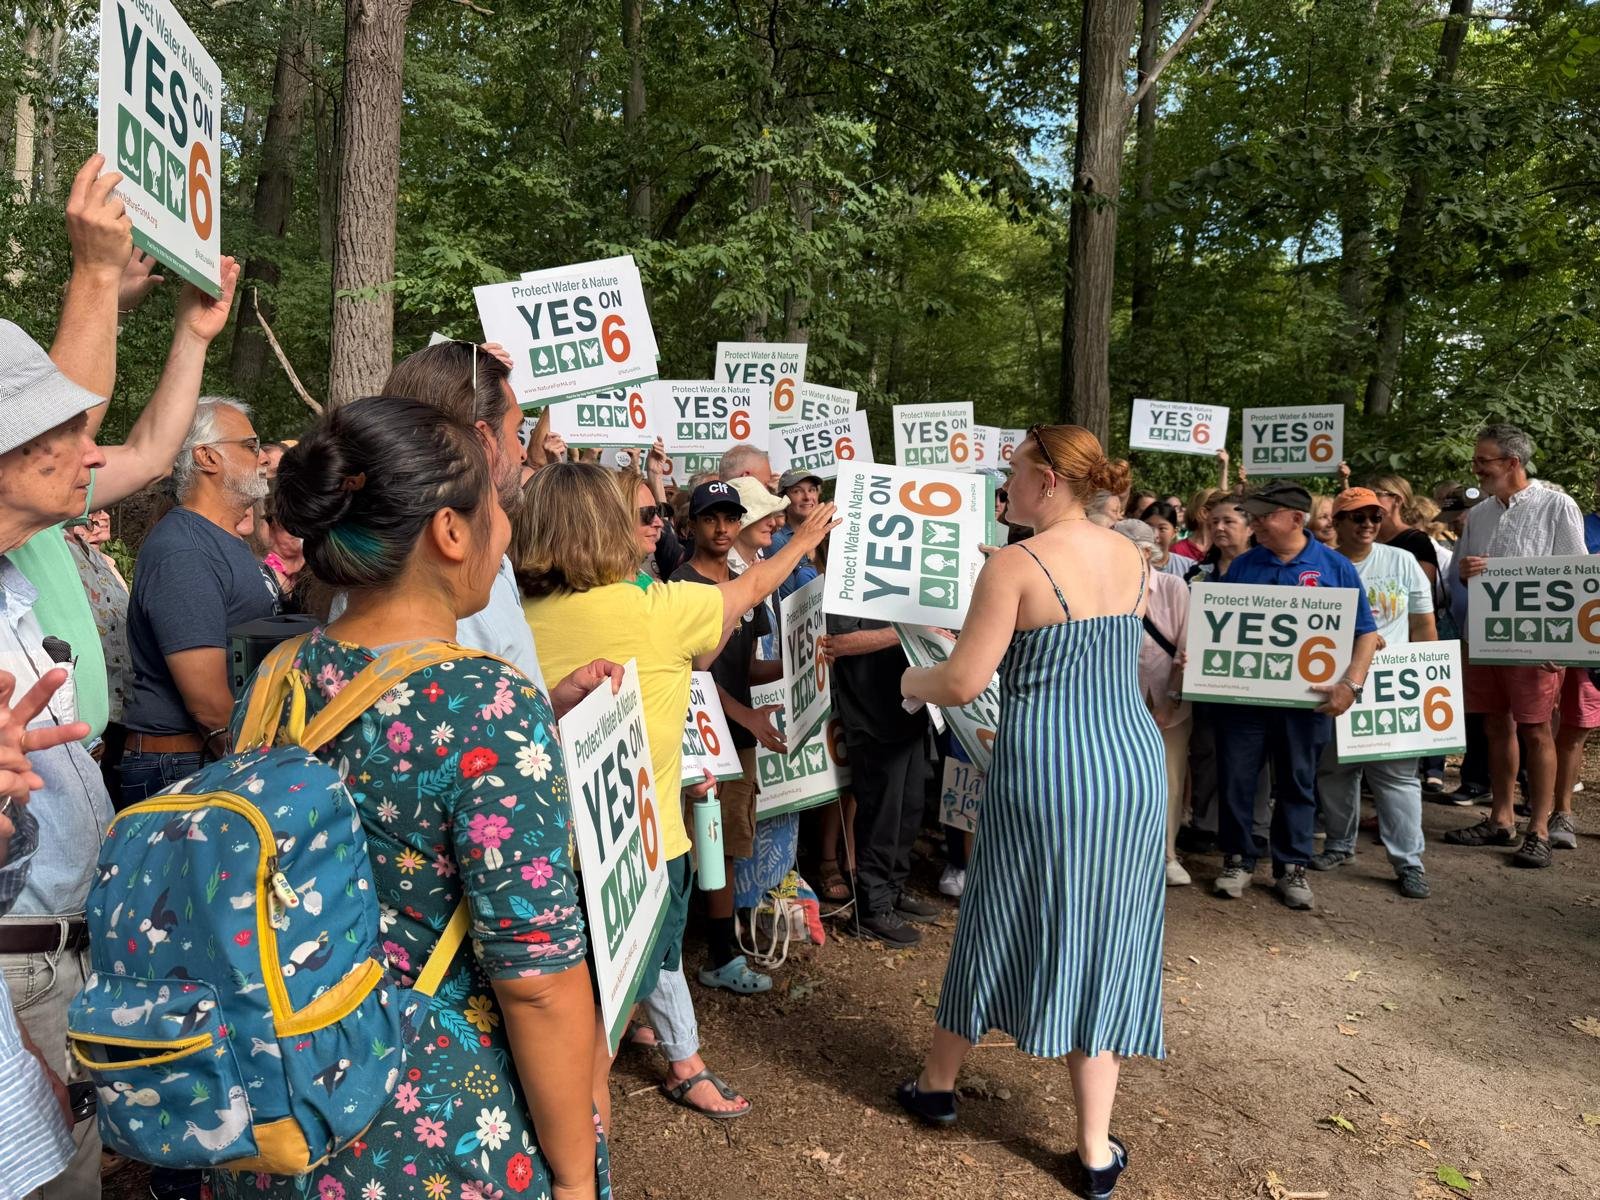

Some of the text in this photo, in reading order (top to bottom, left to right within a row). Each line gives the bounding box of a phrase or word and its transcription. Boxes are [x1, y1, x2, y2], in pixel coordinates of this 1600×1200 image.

[132, 0, 213, 100] tect Water & Nature
[117, 1, 213, 148] YES ON
[189, 141, 213, 241] 6
[511, 276, 618, 298] Protect Water & Nature
[516, 290, 622, 340] YES ON
[602, 314, 630, 363] 6
[724, 351, 750, 359] Protect
[772, 352, 776, 360] &
[777, 352, 799, 360] Nature
[671, 385, 698, 393] Protect
[725, 362, 798, 387] YES ON
[673, 396, 750, 418] YES ON
[774, 378, 795, 412] 6
[806, 390, 825, 399] Water
[831, 394, 850, 404] Nature
[629, 392, 647, 429] 6
[729, 410, 751, 440] 6
[801, 400, 849, 421] ES ON
[900, 411, 923, 419] Protect
[924, 410, 941, 418] Water
[1150, 410, 1212, 427] YES ON
[1250, 414, 1277, 422] Protect
[1308, 411, 1334, 419] Nature
[781, 424, 805, 436] Protect
[806, 422, 822, 430] Water
[829, 417, 849, 426] Nature
[784, 424, 851, 454] YES ON
[902, 419, 967, 444] YES ON
[1192, 423, 1210, 444] 6
[1251, 420, 1334, 443] YES ON
[835, 437, 855, 460] 6
[949, 432, 969, 463] 6
[1002, 444, 1014, 461] 6
[1309, 434, 1334, 463] 6
[709, 483, 729, 494] clf
[848, 474, 865, 511] Nature
[899, 480, 962, 516] 6
[844, 522, 860, 553] Water
[862, 475, 914, 602] YES ON
[839, 556, 857, 600] Protect
[1480, 564, 1600, 576] Protect Water & Natu
[1204, 593, 1342, 611] Protect Water & Nature
[1481, 578, 1600, 612] YES O
[788, 609, 823, 676] YES ON
[1204, 610, 1341, 648] YES ON
[815, 635, 826, 693] 6
[1297, 636, 1337, 684] 6
[1381, 654, 1408, 665] Water
[1410, 653, 1417, 662] &
[1418, 652, 1449, 662] Nature
[690, 689, 706, 705] ON
[752, 690, 780, 706] rotect
[1356, 665, 1451, 704] ES ON
[1423, 686, 1454, 731] 6
[575, 690, 638, 768] Protect Water & Nature
[696, 710, 720, 756] 6
[826, 718, 850, 768] 6
[582, 715, 644, 864] YES ON
[637, 767, 658, 872] 6
